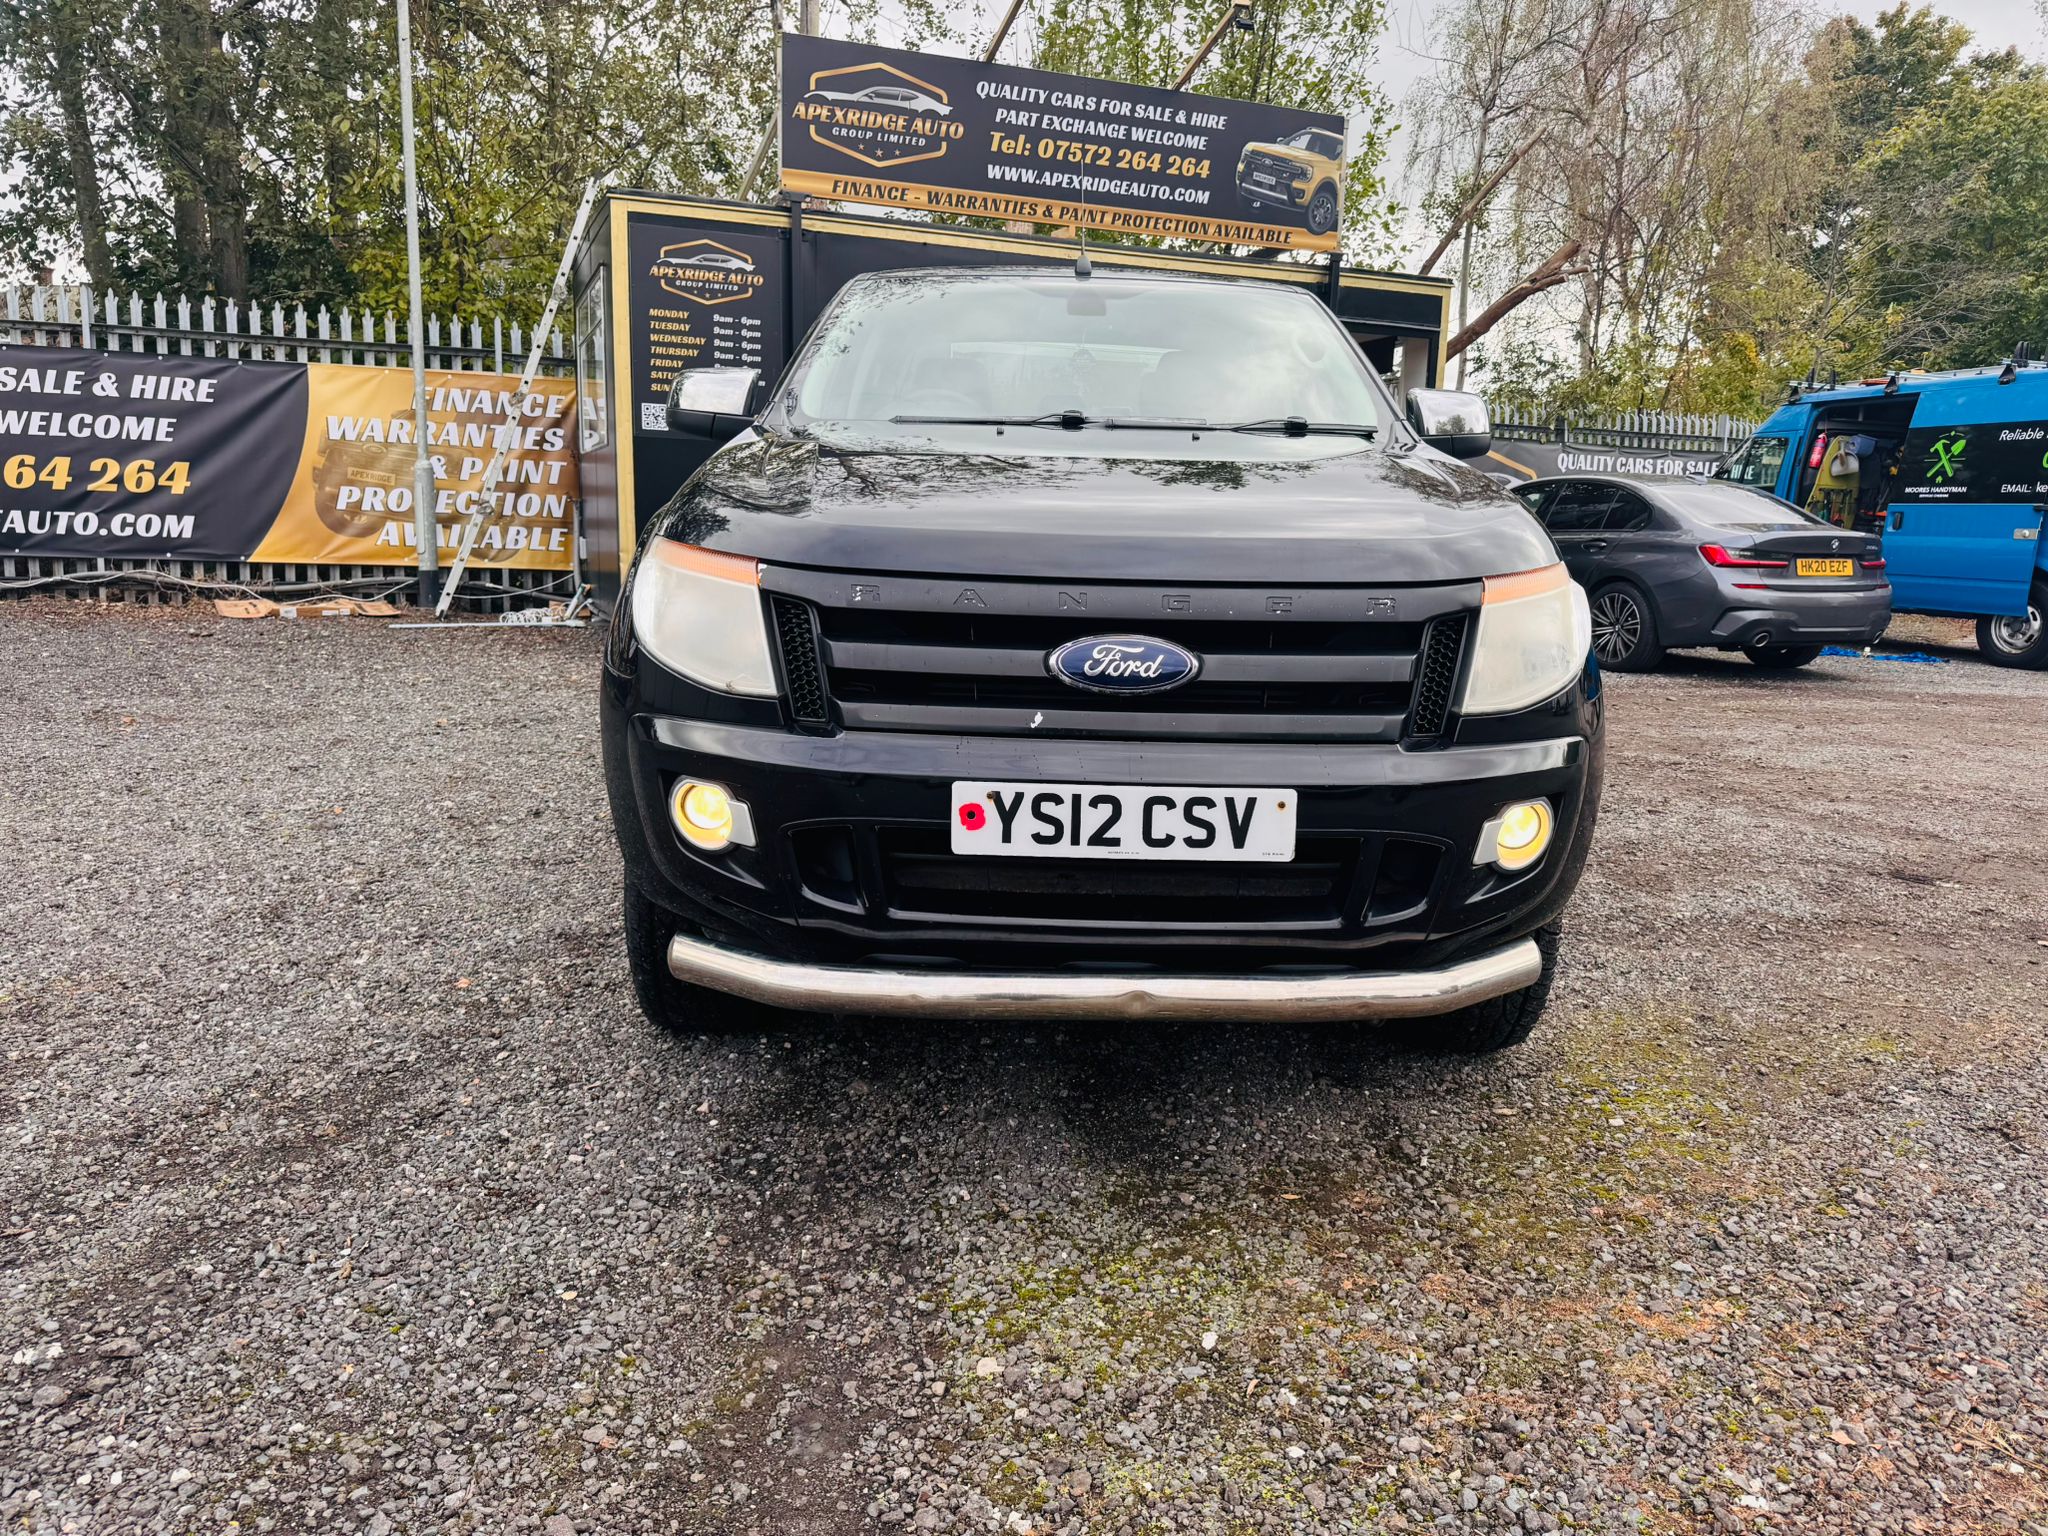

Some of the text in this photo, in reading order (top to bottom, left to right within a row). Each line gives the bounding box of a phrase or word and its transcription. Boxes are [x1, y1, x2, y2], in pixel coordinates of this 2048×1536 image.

[976, 81, 1228, 130] QUALITY CARS FOR SALE & HIRE
[792, 101, 965, 140] APEXRIDGE AUTO
[995, 108, 1209, 150] PART EXCHANGE WELCOME
[832, 126, 926, 147] GROUP LIMITED
[990, 131, 1211, 179] Tel: 07572 264 264
[987, 164, 1210, 205] WWW.APEXRIDGEAUTO.COM
[831, 179, 910, 202] FINANCE
[927, 191, 1039, 217] WARRANTIES
[1042, 204, 1053, 219] &
[1058, 206, 1108, 225] PAINT
[1110, 212, 1209, 236] PROTECTION
[1212, 223, 1293, 245] AVAILABLE
[649, 265, 764, 287] APEXRIDGE AUTO
[675, 280, 739, 291] GROUP LIMITED
[649, 308, 689, 319] MONDAY
[650, 321, 691, 332] TUESDAY
[713, 314, 733, 323] 9am
[741, 316, 761, 326] 6pm
[650, 333, 707, 345] WEDNESDAY
[713, 326, 733, 335] 9am
[741, 329, 761, 338] 6pm
[714, 339, 733, 348] 9am
[741, 341, 761, 351] 6pm
[650, 346, 700, 357] THURSDAY
[650, 358, 684, 368] FRIDAY
[714, 351, 734, 360] 9am
[741, 353, 761, 363] 6pm
[0, 366, 218, 403] SALE & HIRE
[0, 409, 177, 442] WELCOME
[326, 415, 565, 452] WARRANTIES
[1999, 427, 2045, 441] Reliable
[86, 457, 191, 495] 264
[429, 455, 448, 480] &
[1557, 452, 1614, 473] QUALITY
[1615, 456, 1655, 473] CARS
[1656, 459, 1685, 475] FOR
[1686, 461, 1720, 477] SALE
[1731, 464, 1755, 479] HIE
[2000, 484, 2032, 493] EMAIL:
[336, 486, 567, 518] PROECION
[0, 509, 195, 539] AUTO.COM
[1801, 560, 1848, 573] HK20 EZF
[850, 583, 1397, 616] RANGER
[1083, 644, 1163, 680] Ford
[989, 790, 1258, 850] YS12 CSV
